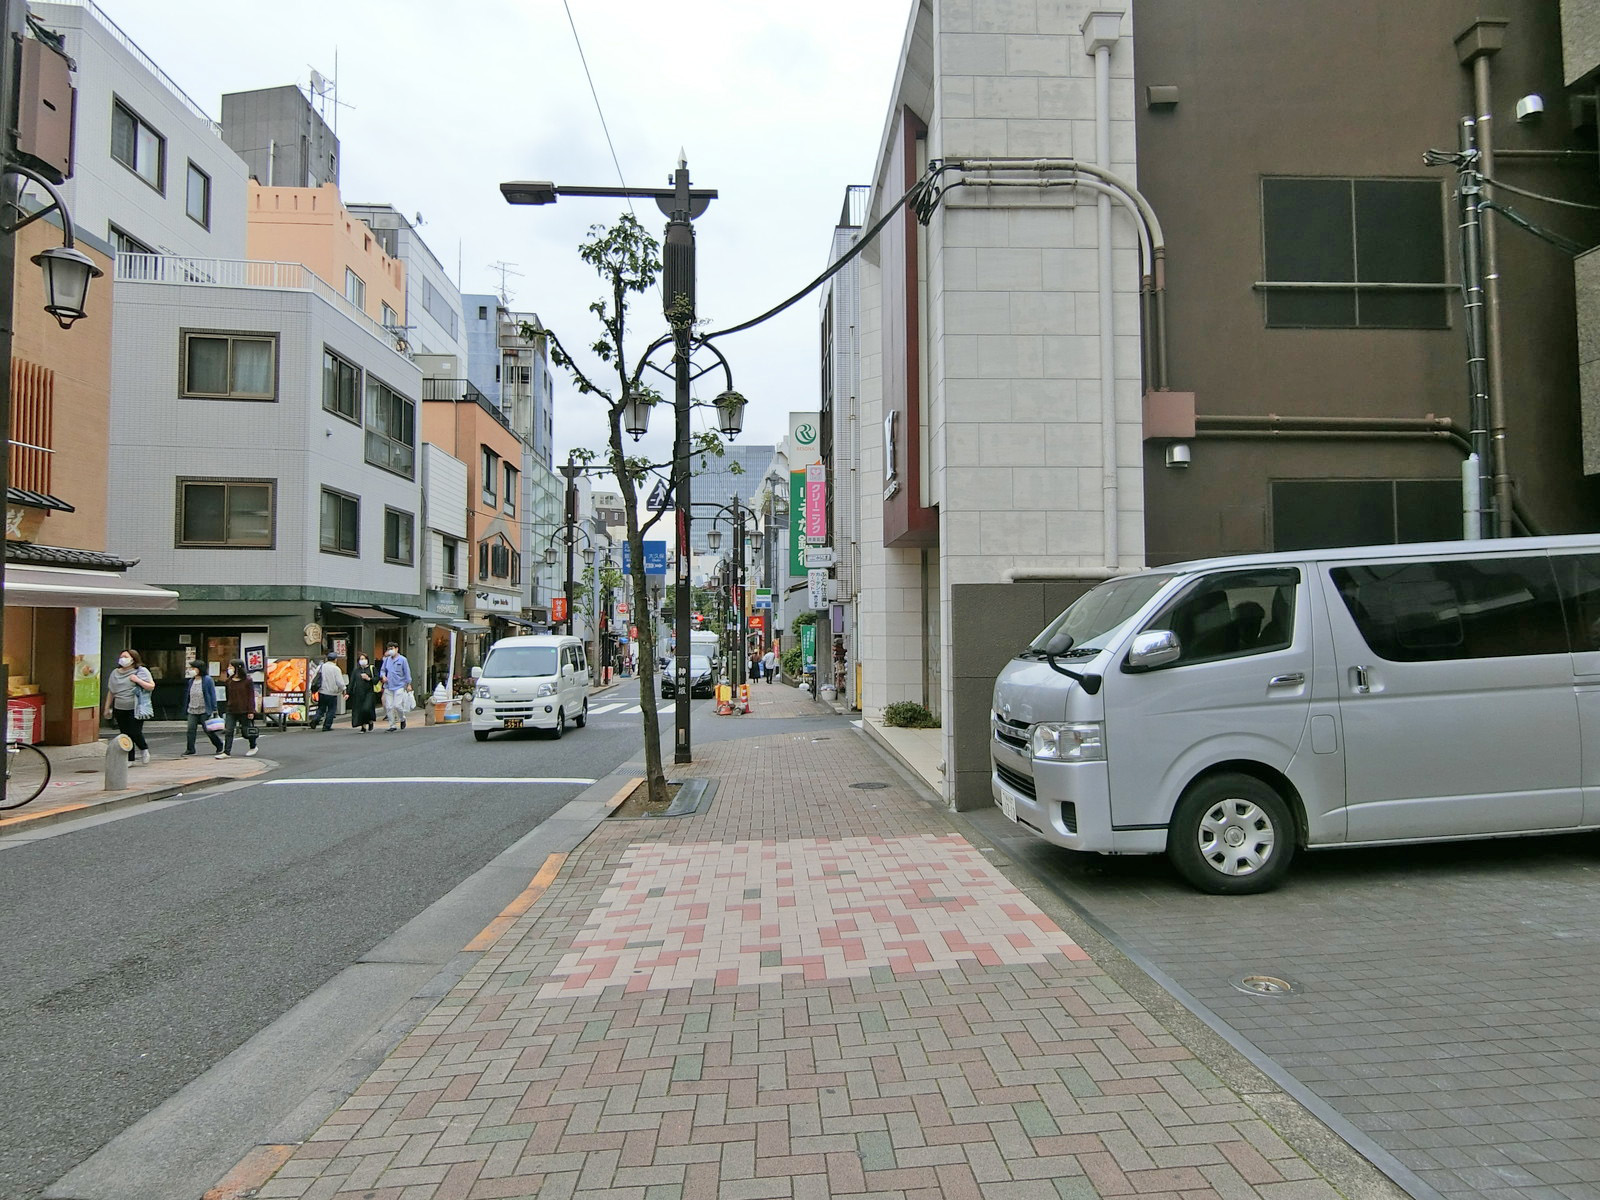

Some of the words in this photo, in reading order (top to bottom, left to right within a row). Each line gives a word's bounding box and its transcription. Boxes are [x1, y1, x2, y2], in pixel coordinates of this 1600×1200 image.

[811, 484, 821, 534] クリーニング
[249, 655, 262, 665] 氷
[677, 667, 687, 695] 神楽坂
